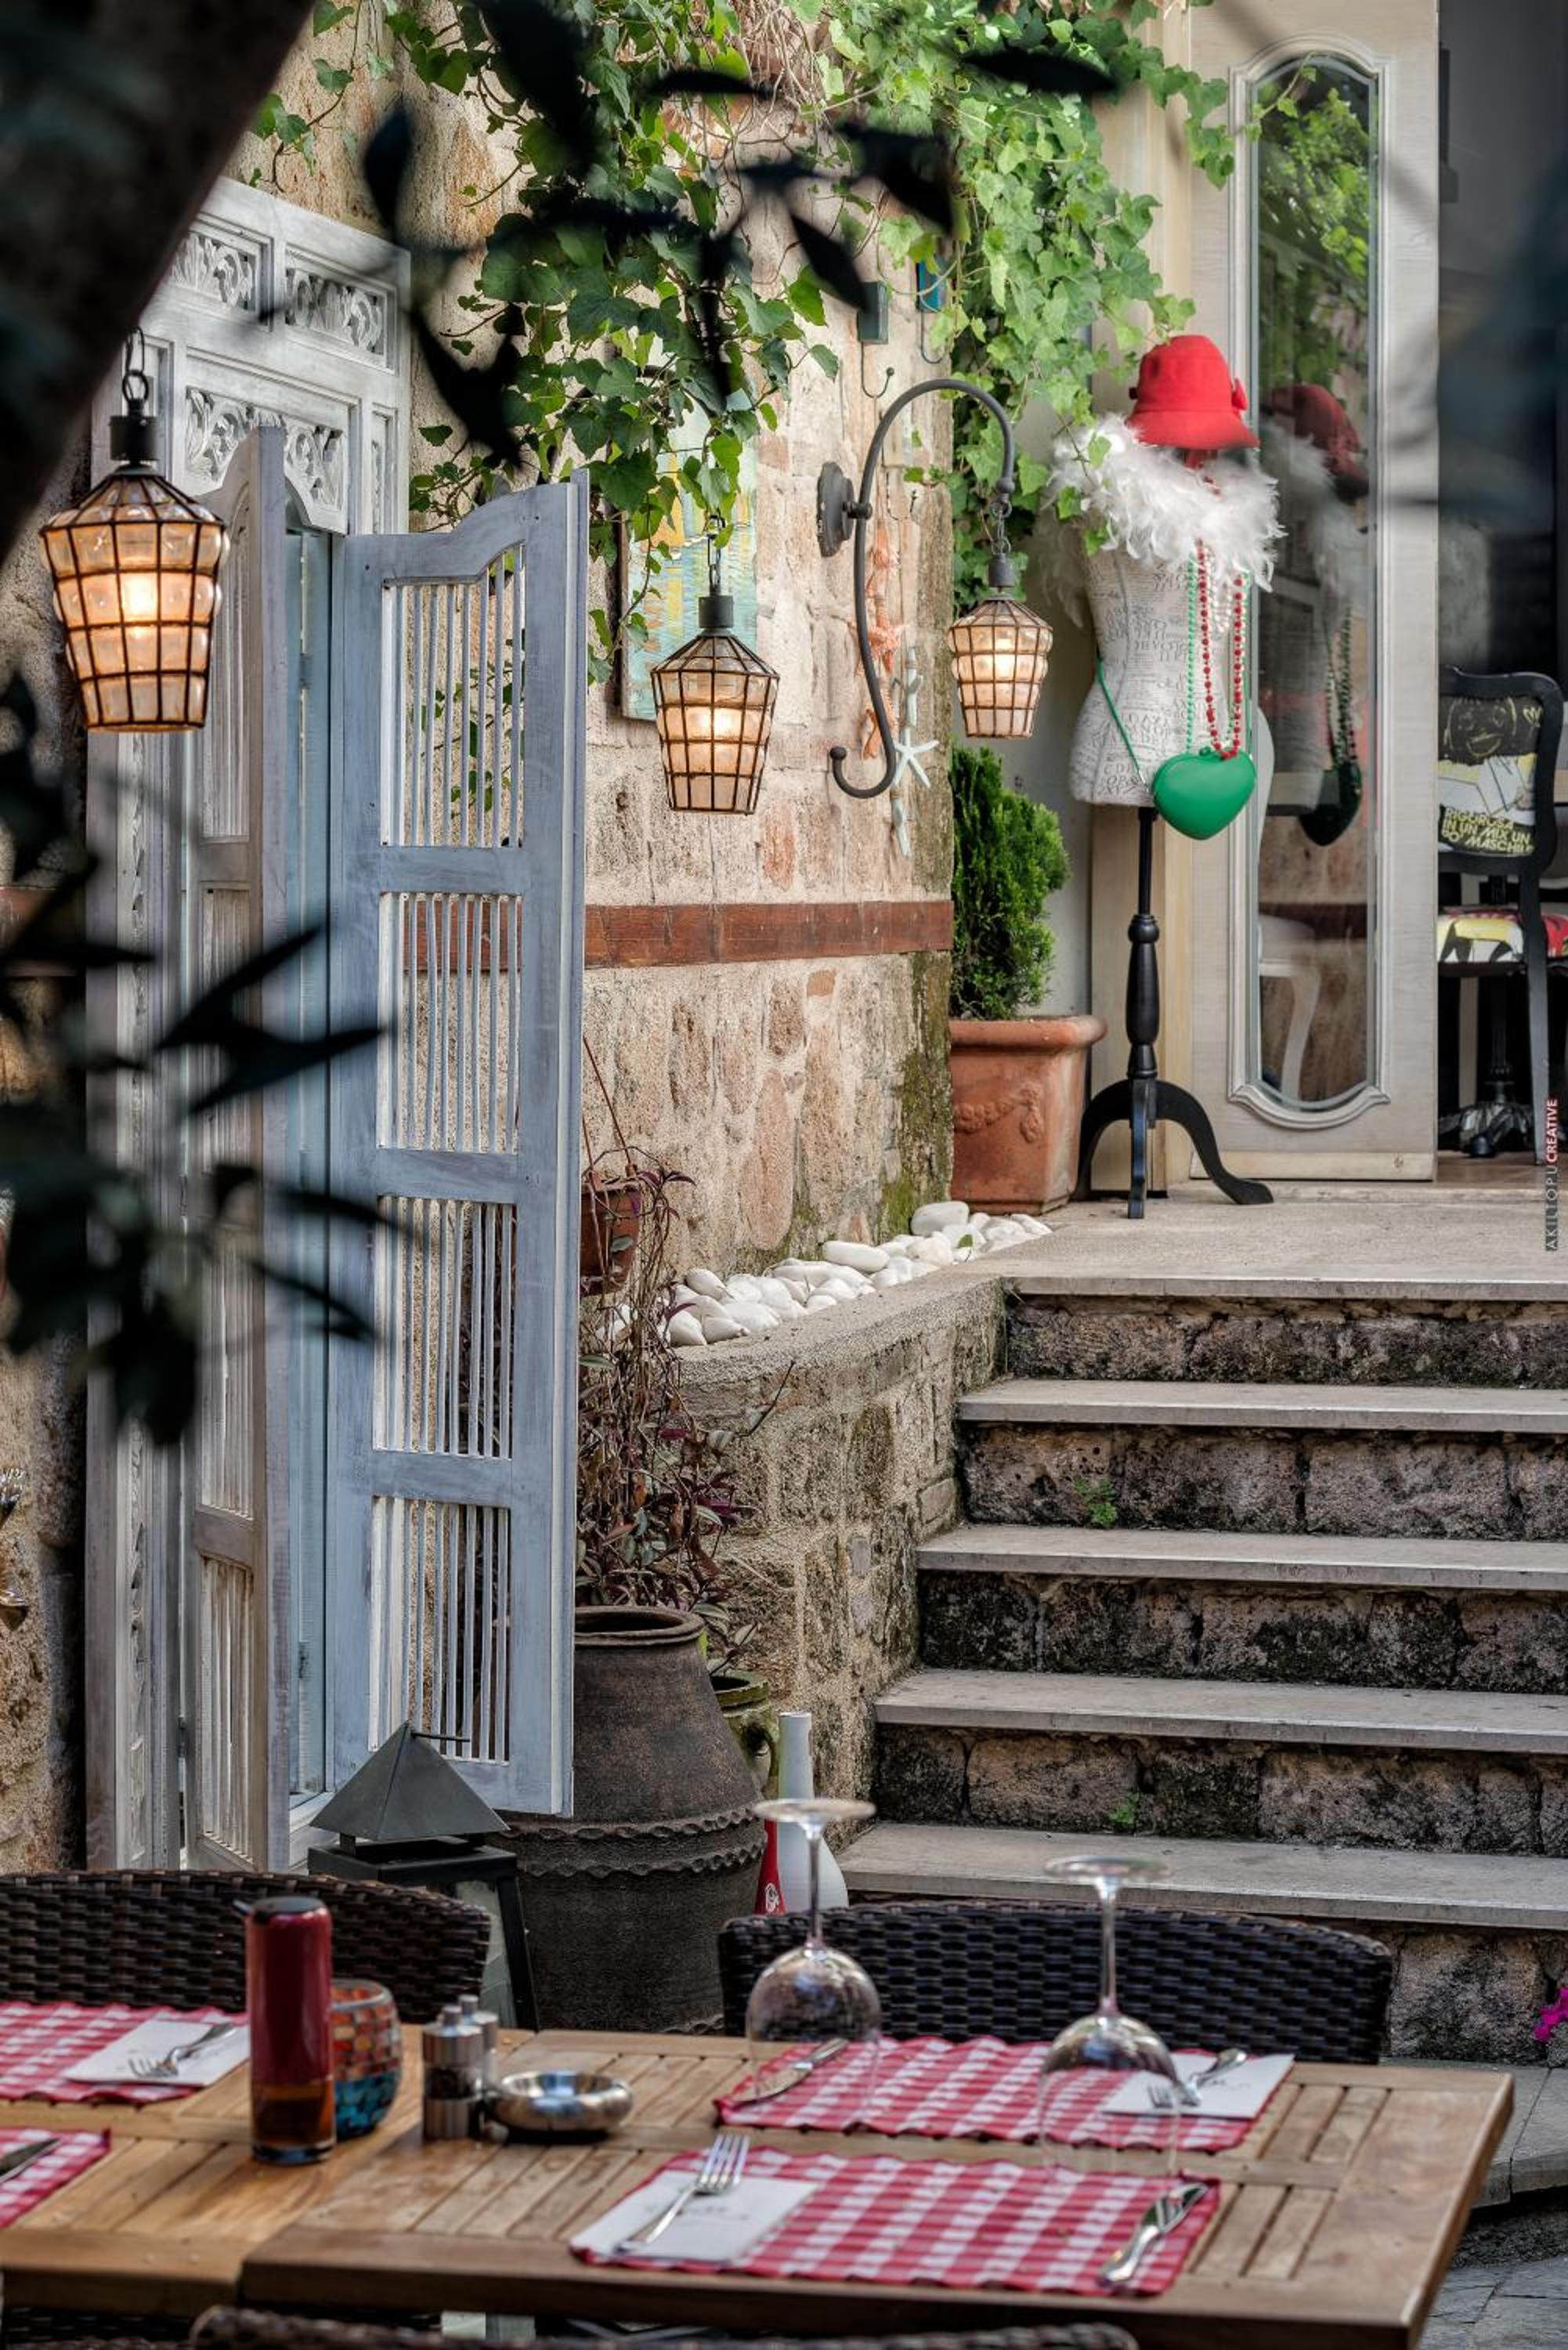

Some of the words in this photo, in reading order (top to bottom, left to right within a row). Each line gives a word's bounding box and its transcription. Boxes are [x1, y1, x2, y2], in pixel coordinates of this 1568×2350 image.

[1442, 819, 1457, 831] IN
[1459, 822, 1479, 835] UN
[1479, 827, 1508, 841] MIX
[1512, 831, 1531, 844] UN
